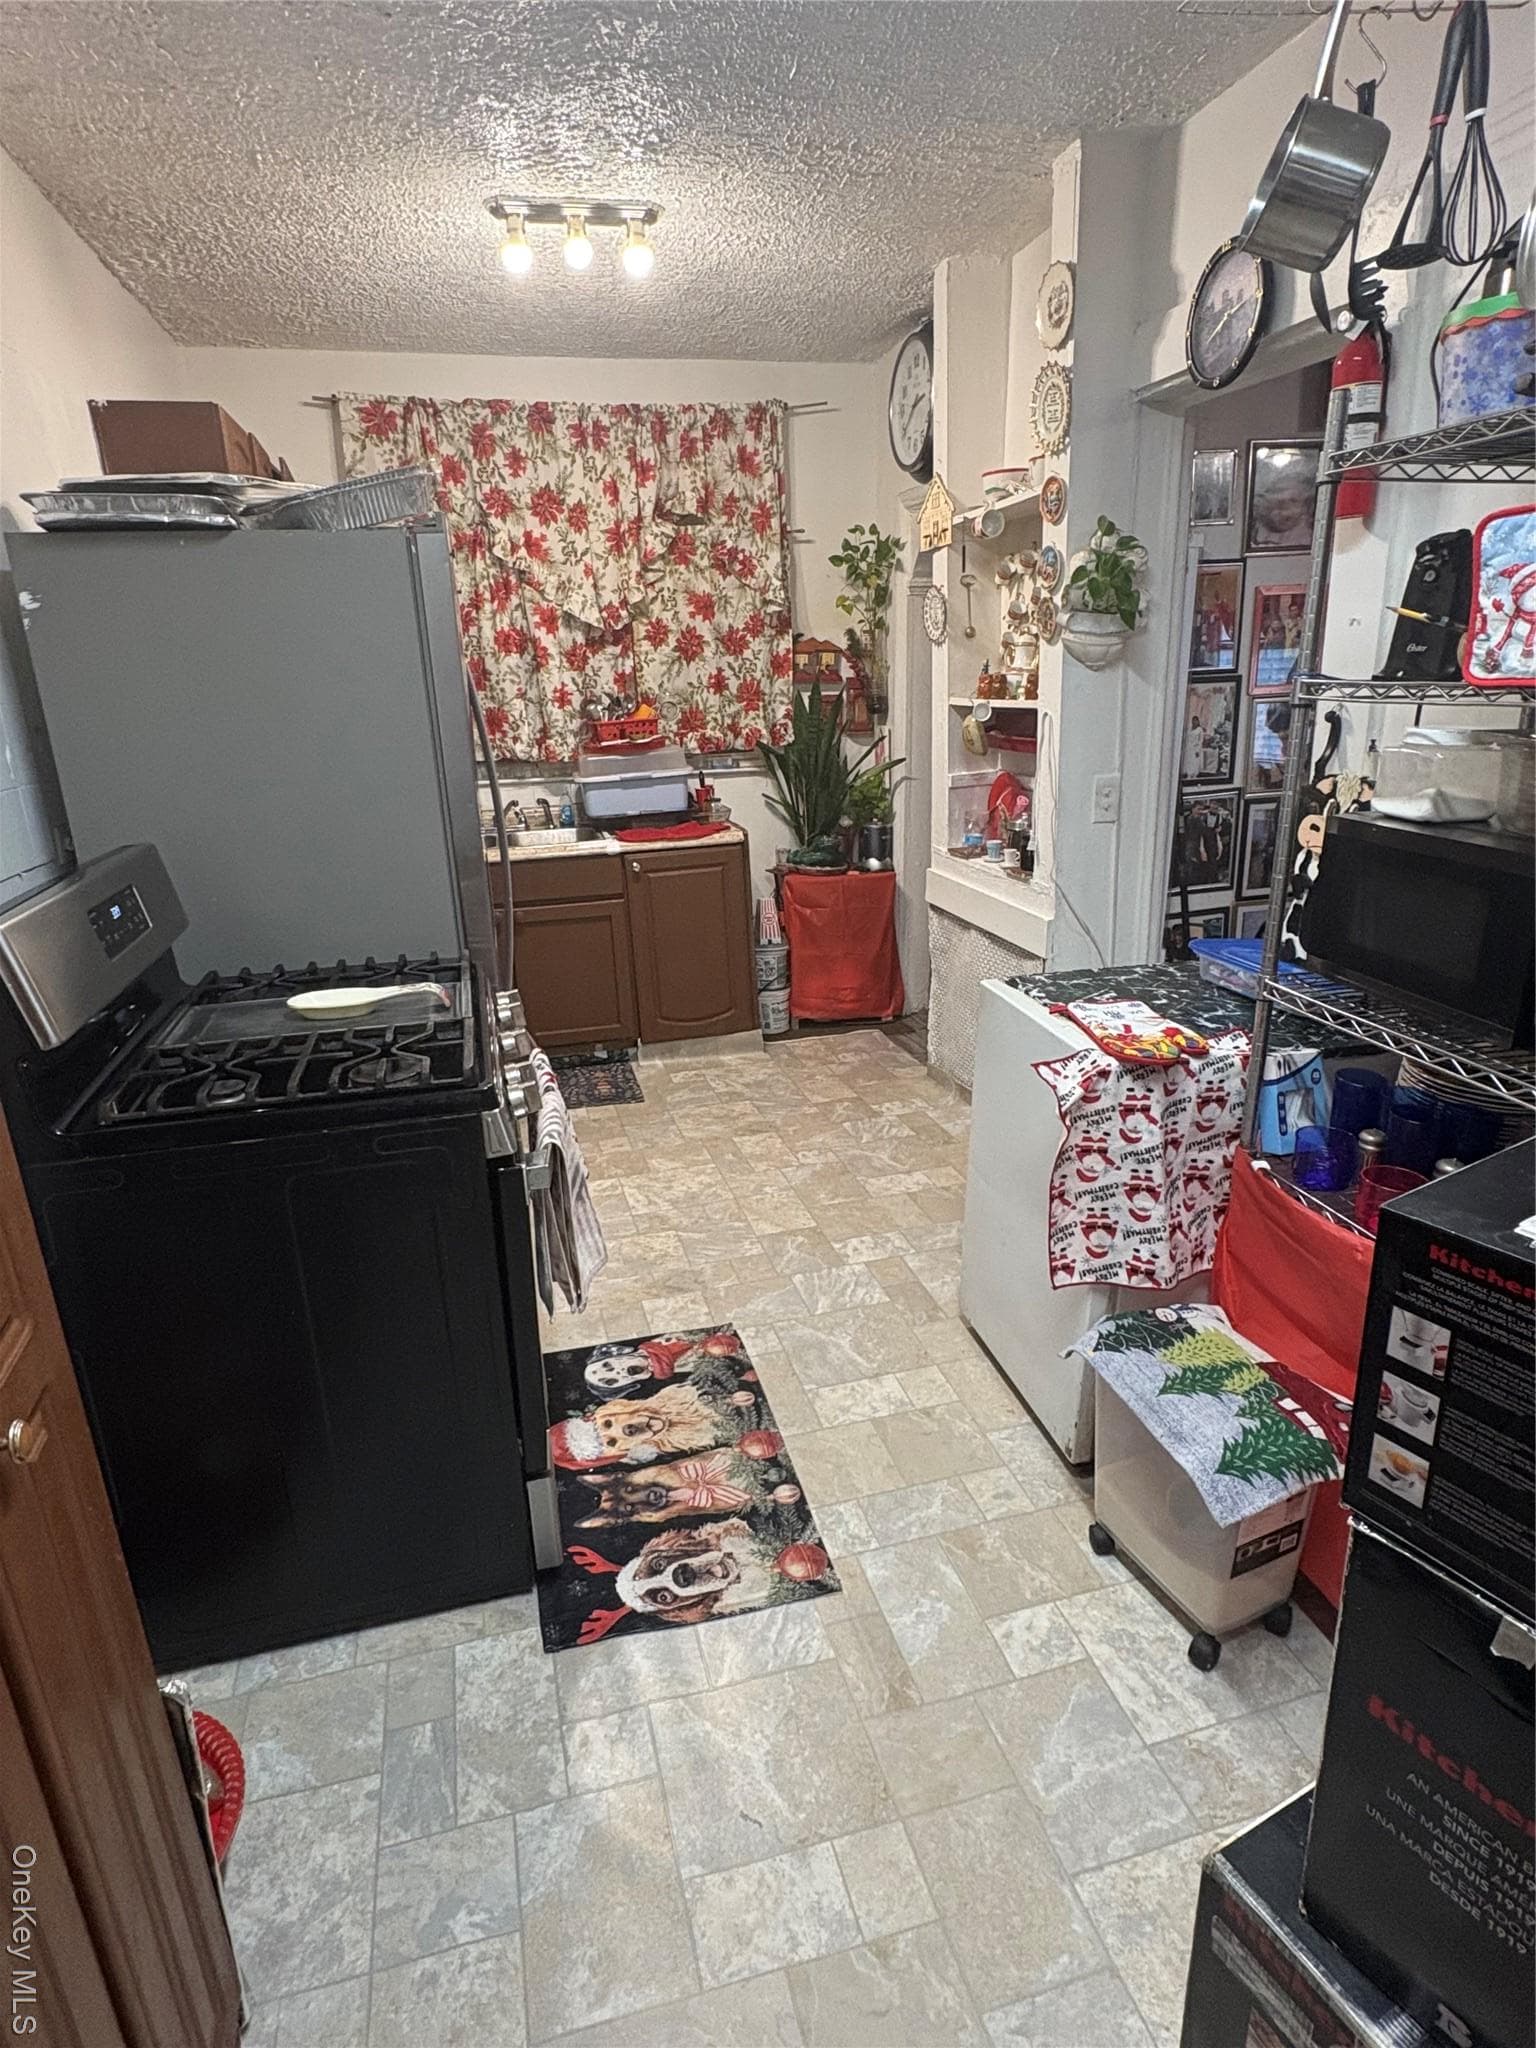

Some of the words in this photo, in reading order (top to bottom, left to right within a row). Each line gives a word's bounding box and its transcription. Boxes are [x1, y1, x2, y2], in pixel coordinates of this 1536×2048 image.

[1365, 1803, 1396, 1836] UNA
[1399, 1832, 1454, 1883] MARCA
[1385, 1787, 1418, 1820] UNE
[1420, 1813, 1488, 1878] MARQUE
[1406, 1772, 1431, 1796] AN
[1433, 1794, 1519, 1864] AMERICAN
[1442, 1814, 1491, 1858] SINCE
[1433, 1841, 1489, 1892] DEPUIS
[1429, 1871, 1482, 1922] DESDE
[1487, 1919, 1527, 1954] 1919
